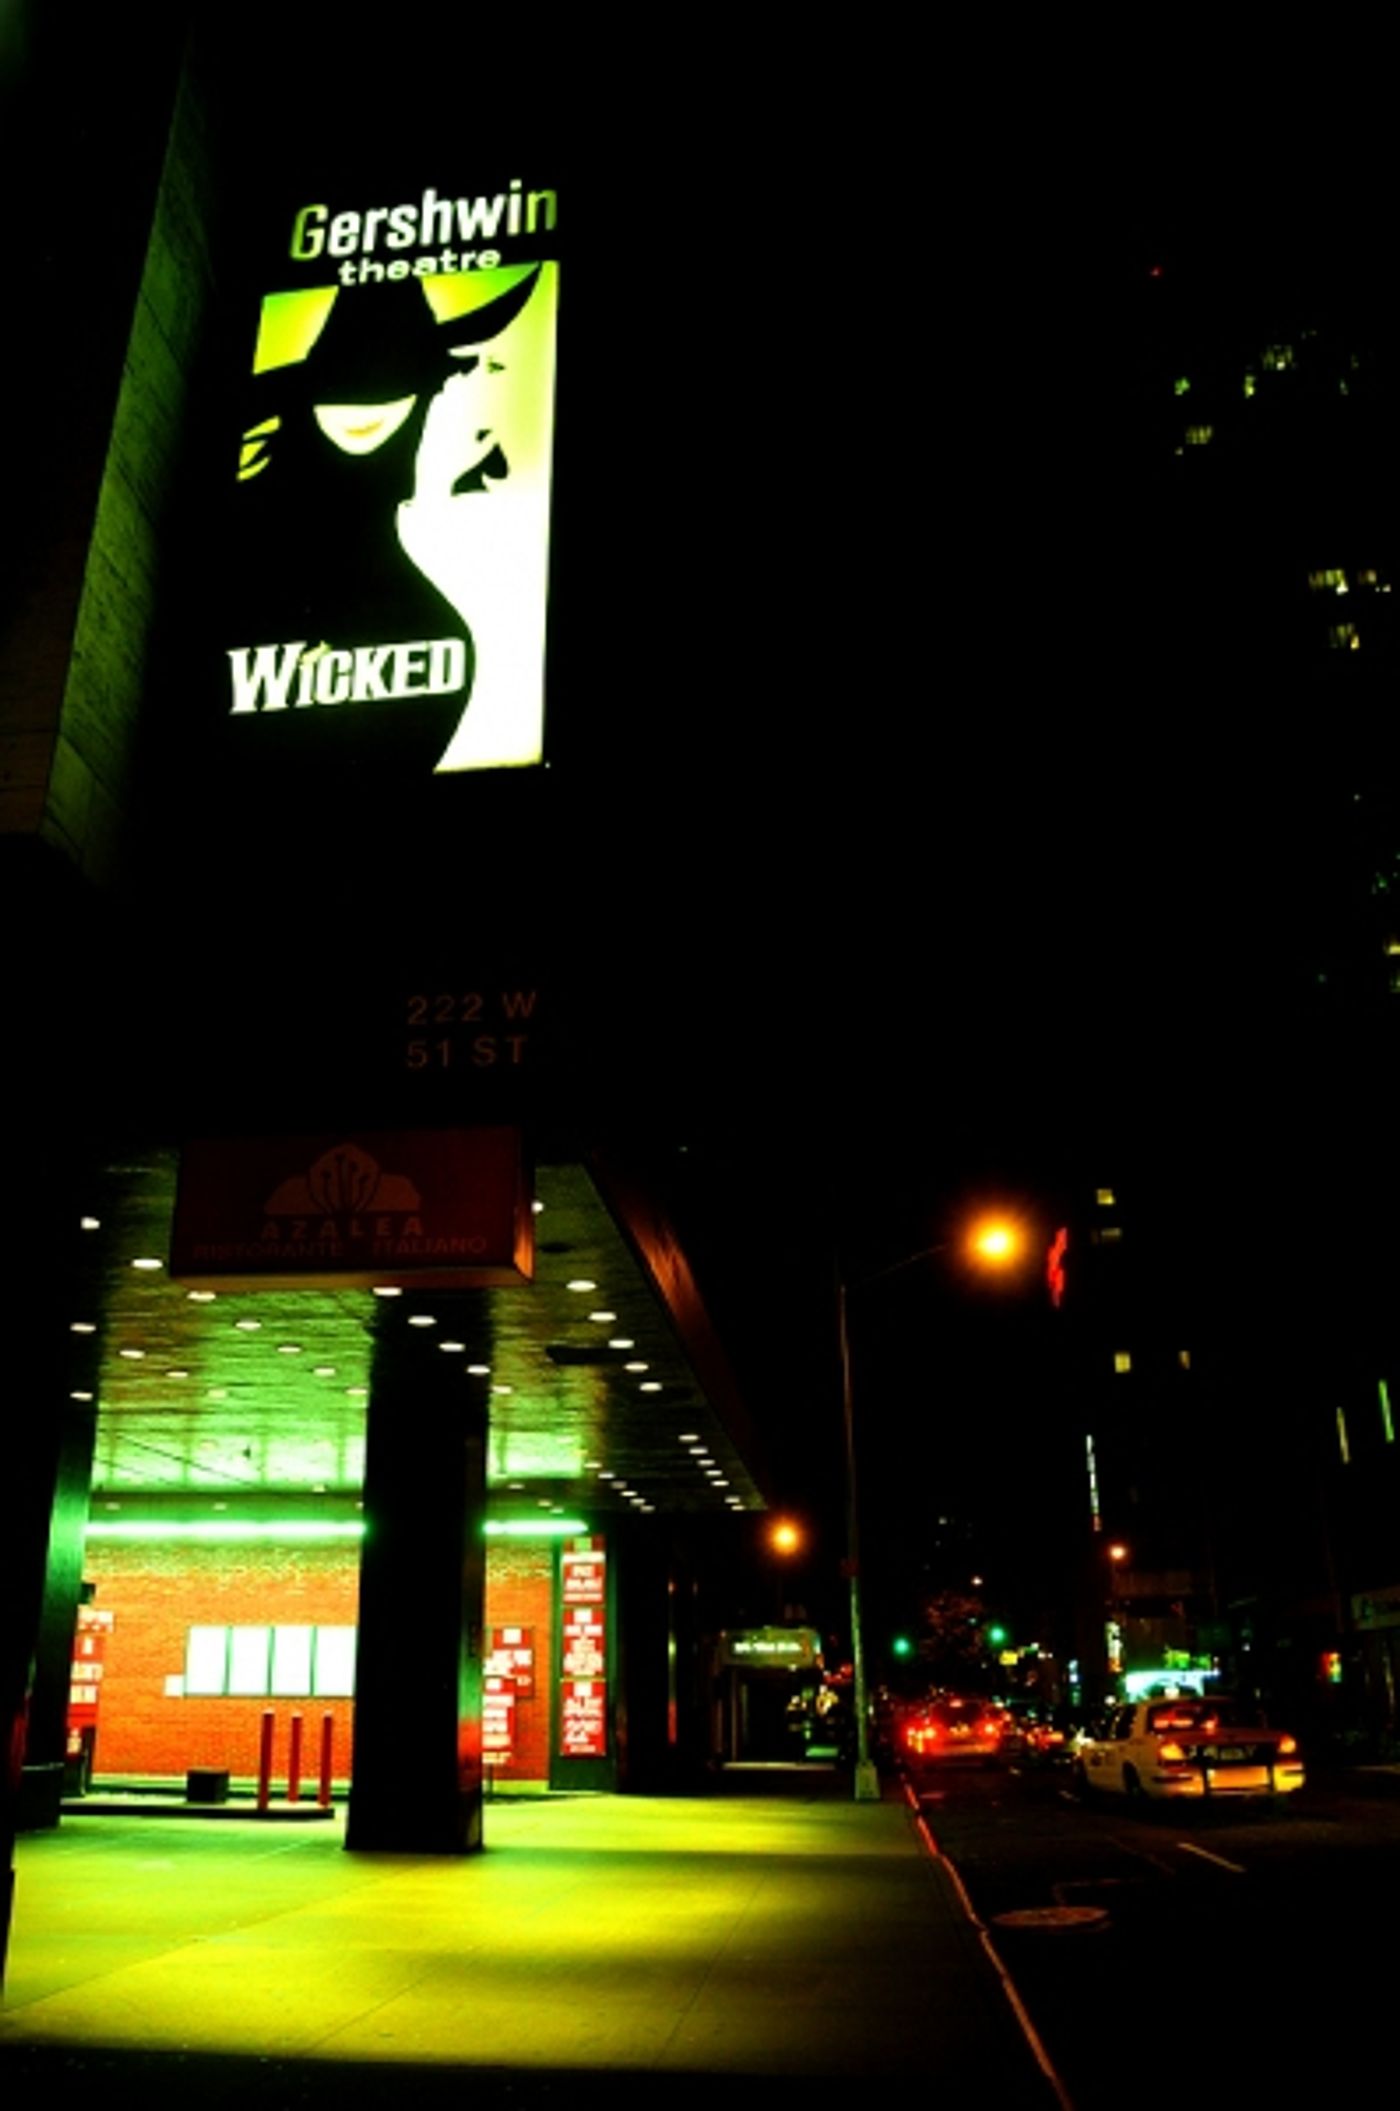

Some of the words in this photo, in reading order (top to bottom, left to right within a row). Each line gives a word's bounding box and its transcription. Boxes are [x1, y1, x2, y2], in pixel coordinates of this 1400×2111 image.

[289, 179, 559, 261] Gershwin
[338, 248, 503, 286] theatre
[227, 637, 467, 714] WICKED
[405, 993, 485, 1026] 222
[499, 989, 538, 1021] W
[405, 1037, 454, 1071] 51
[470, 1032, 530, 1068] ST
[192, 1240, 345, 1261] RISTORANTE
[372, 1235, 488, 1257] ITALIANO
[261, 1217, 426, 1241] AZALEA
